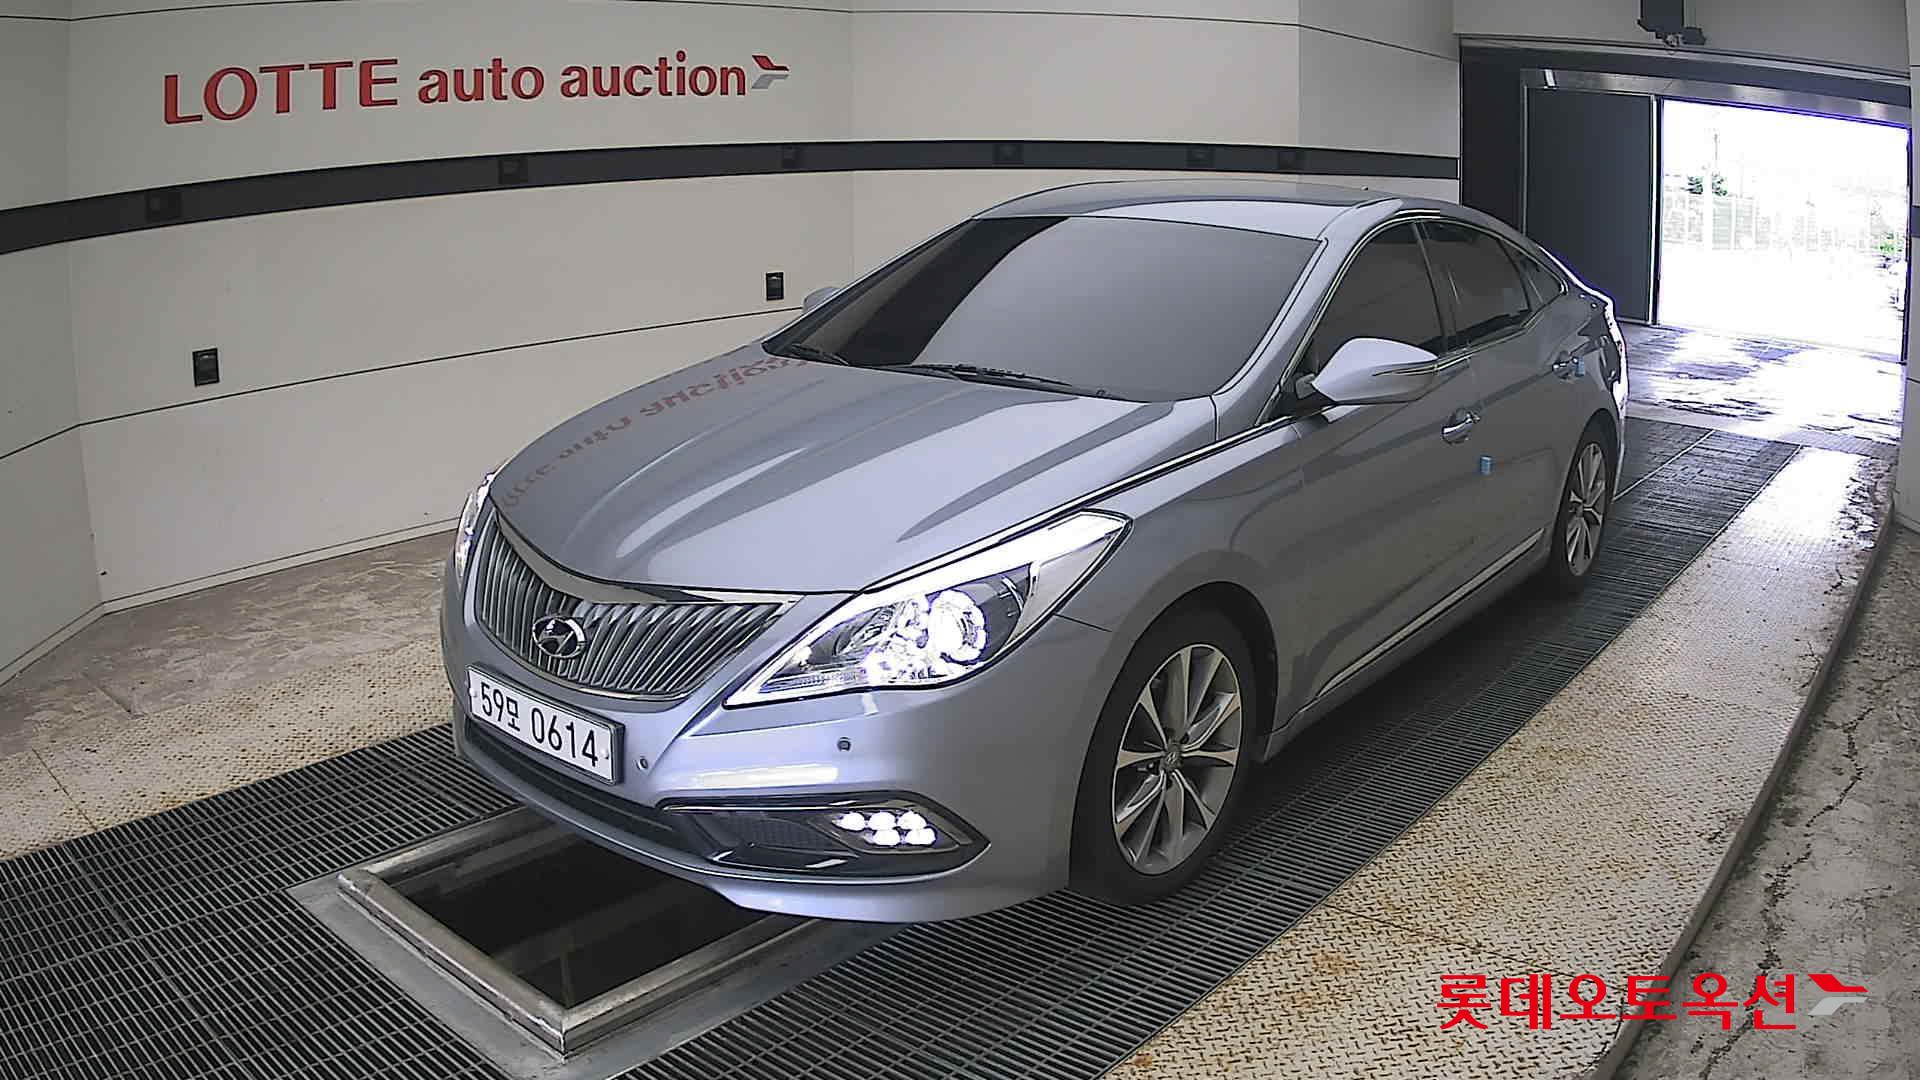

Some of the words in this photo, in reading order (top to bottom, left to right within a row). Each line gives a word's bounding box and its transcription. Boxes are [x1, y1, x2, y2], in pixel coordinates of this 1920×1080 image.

[164, 58, 398, 124] LOTTE
[418, 57, 545, 104] auto
[560, 50, 747, 98] auction
[480, 682, 521, 732] 59모
[531, 707, 599, 767] 0614
